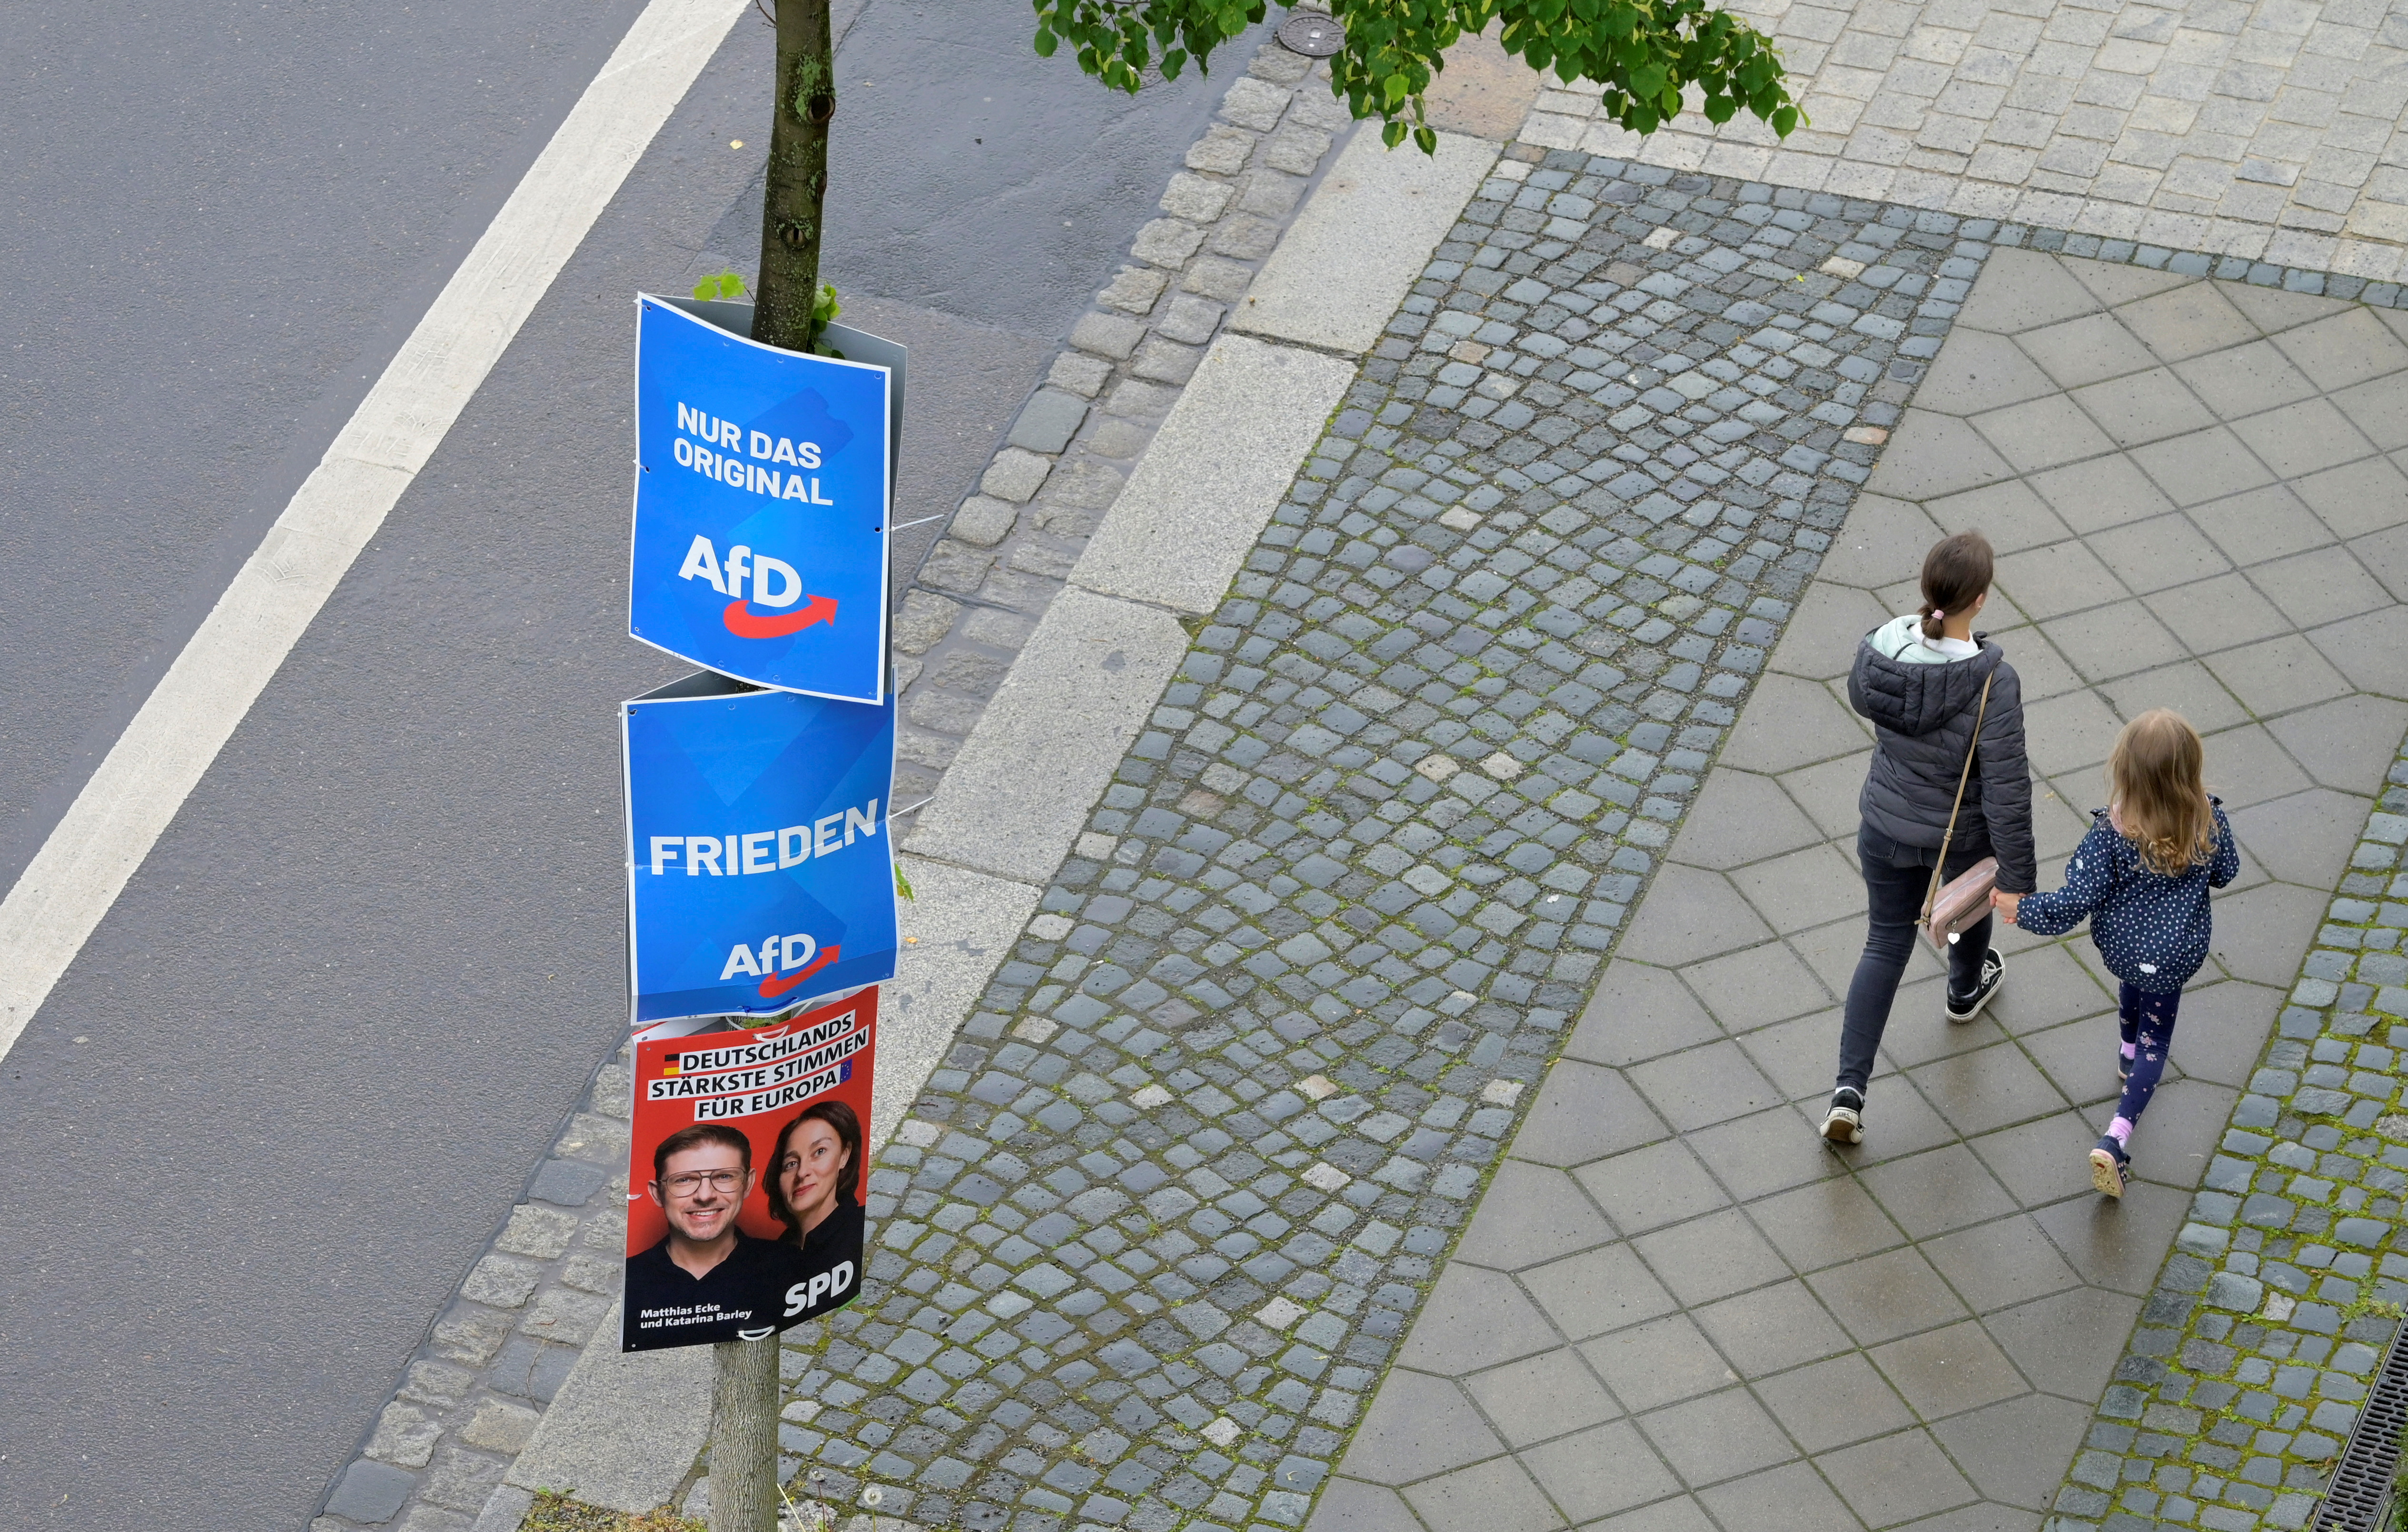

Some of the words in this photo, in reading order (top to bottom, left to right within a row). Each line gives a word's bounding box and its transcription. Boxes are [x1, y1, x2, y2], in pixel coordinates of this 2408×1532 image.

[678, 402, 742, 453] NUR
[750, 430, 821, 469] DAS
[674, 438, 833, 505] ORIGINAL
[678, 534, 802, 607] AfD
[650, 798, 878, 876] FRIEDEN
[720, 933, 816, 980] AfD
[652, 1069, 766, 1097] STÄRKSTE
[774, 1028, 866, 1082] STIMMEN
[684, 1014, 852, 1071] DEUTSCHLANDS
[698, 1096, 743, 1118] FÜR
[752, 1070, 837, 1112] EUROPA
[640, 1305, 693, 1318] Matthias
[695, 1303, 721, 1314] Ecke
[783, 1260, 854, 1317] SPD
[640, 1318, 663, 1329] und
[665, 1315, 713, 1327] Katarina
[716, 1309, 753, 1321] Barley
